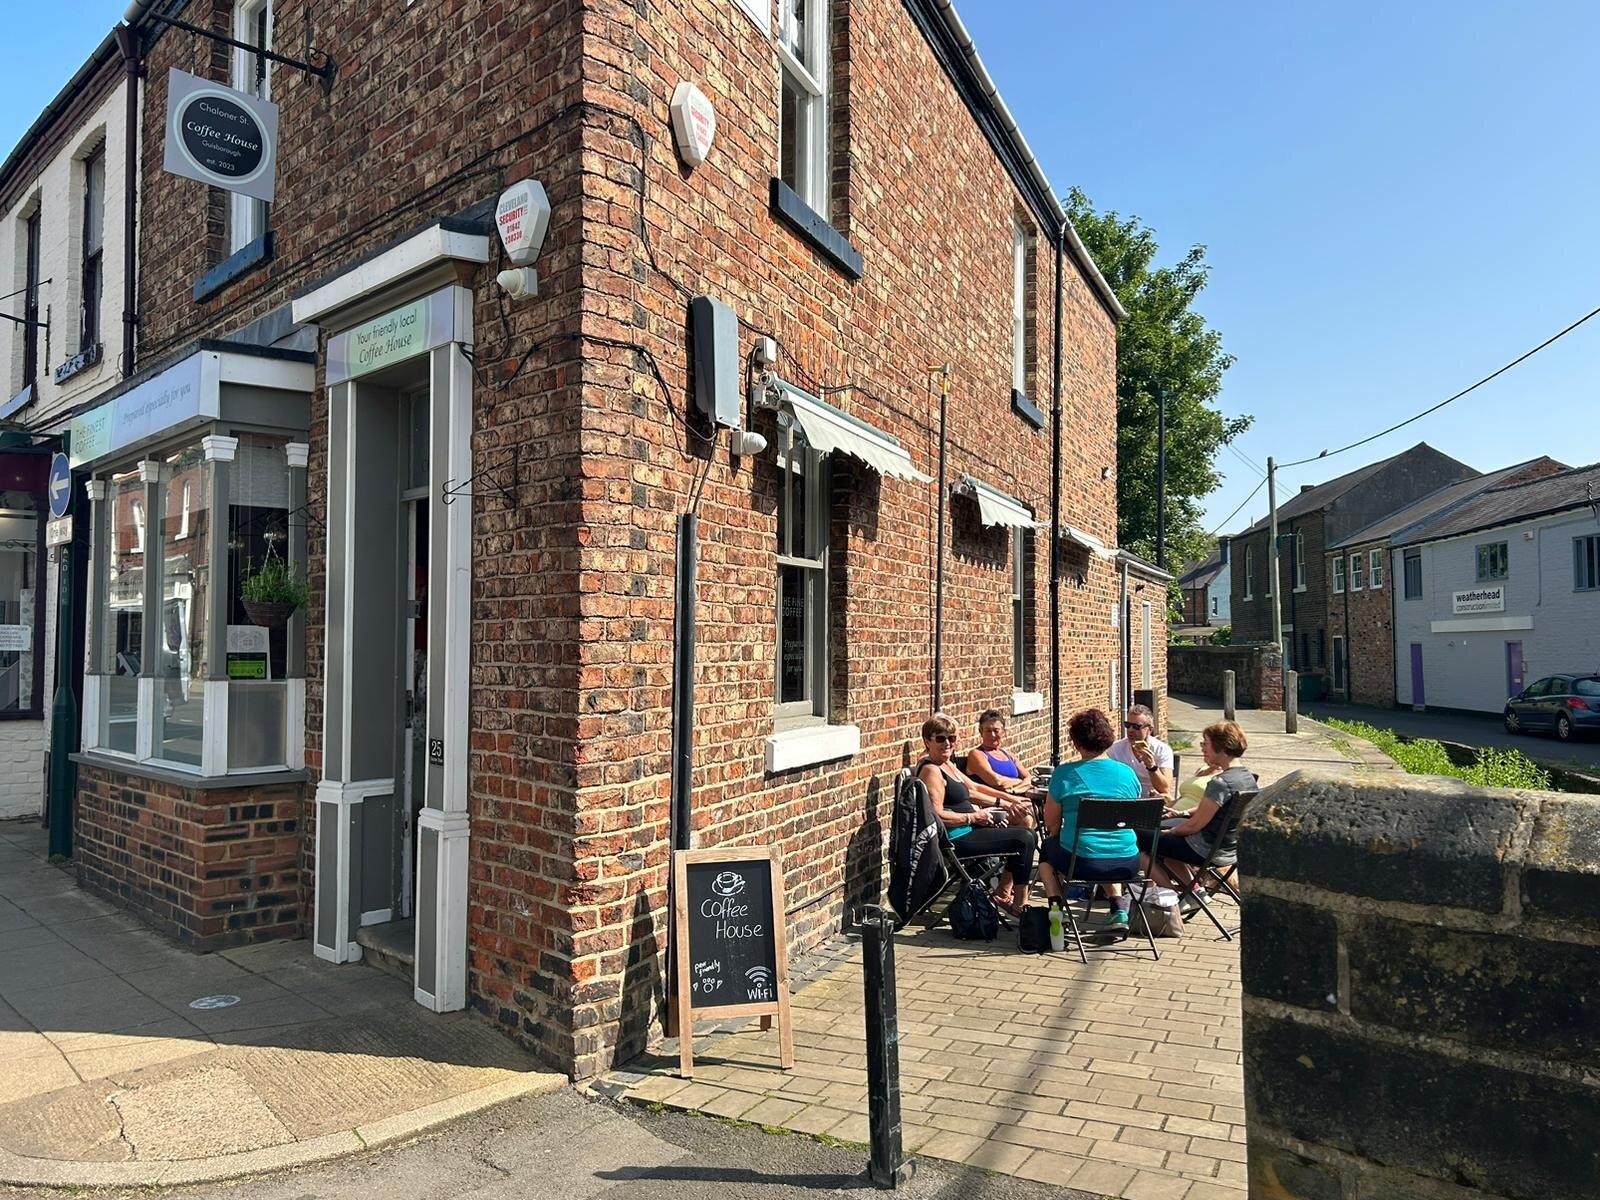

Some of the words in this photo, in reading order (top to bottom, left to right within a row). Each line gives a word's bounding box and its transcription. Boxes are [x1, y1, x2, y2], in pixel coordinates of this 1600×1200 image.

[199, 102, 237, 121] Chaloner
[240, 115, 249, 126] St.
[187, 120, 221, 138] Coffee
[224, 132, 258, 151] House
[202, 140, 242, 158] Guisborough
[219, 160, 235, 170] 2023
[499, 192, 528, 214] CLEVELAND
[499, 207, 524, 226] SECURITY
[506, 220, 520, 234] 01642
[356, 332, 372, 345] Your
[372, 318, 398, 338] friendly
[400, 308, 417, 328] local
[359, 342, 382, 366] Coffee
[384, 334, 412, 354] House
[179, 383, 191, 402] you
[76, 426, 86, 440] THE
[86, 417, 105, 436] FINEST
[75, 435, 95, 454] COFFEE
[792, 597, 804, 608] FINE
[1456, 588, 1500, 602] weatherhead
[431, 740, 442, 757] 25
[700, 897, 748, 920] Coffee
[716, 920, 764, 938] House
[699, 960, 720, 977] friendly
